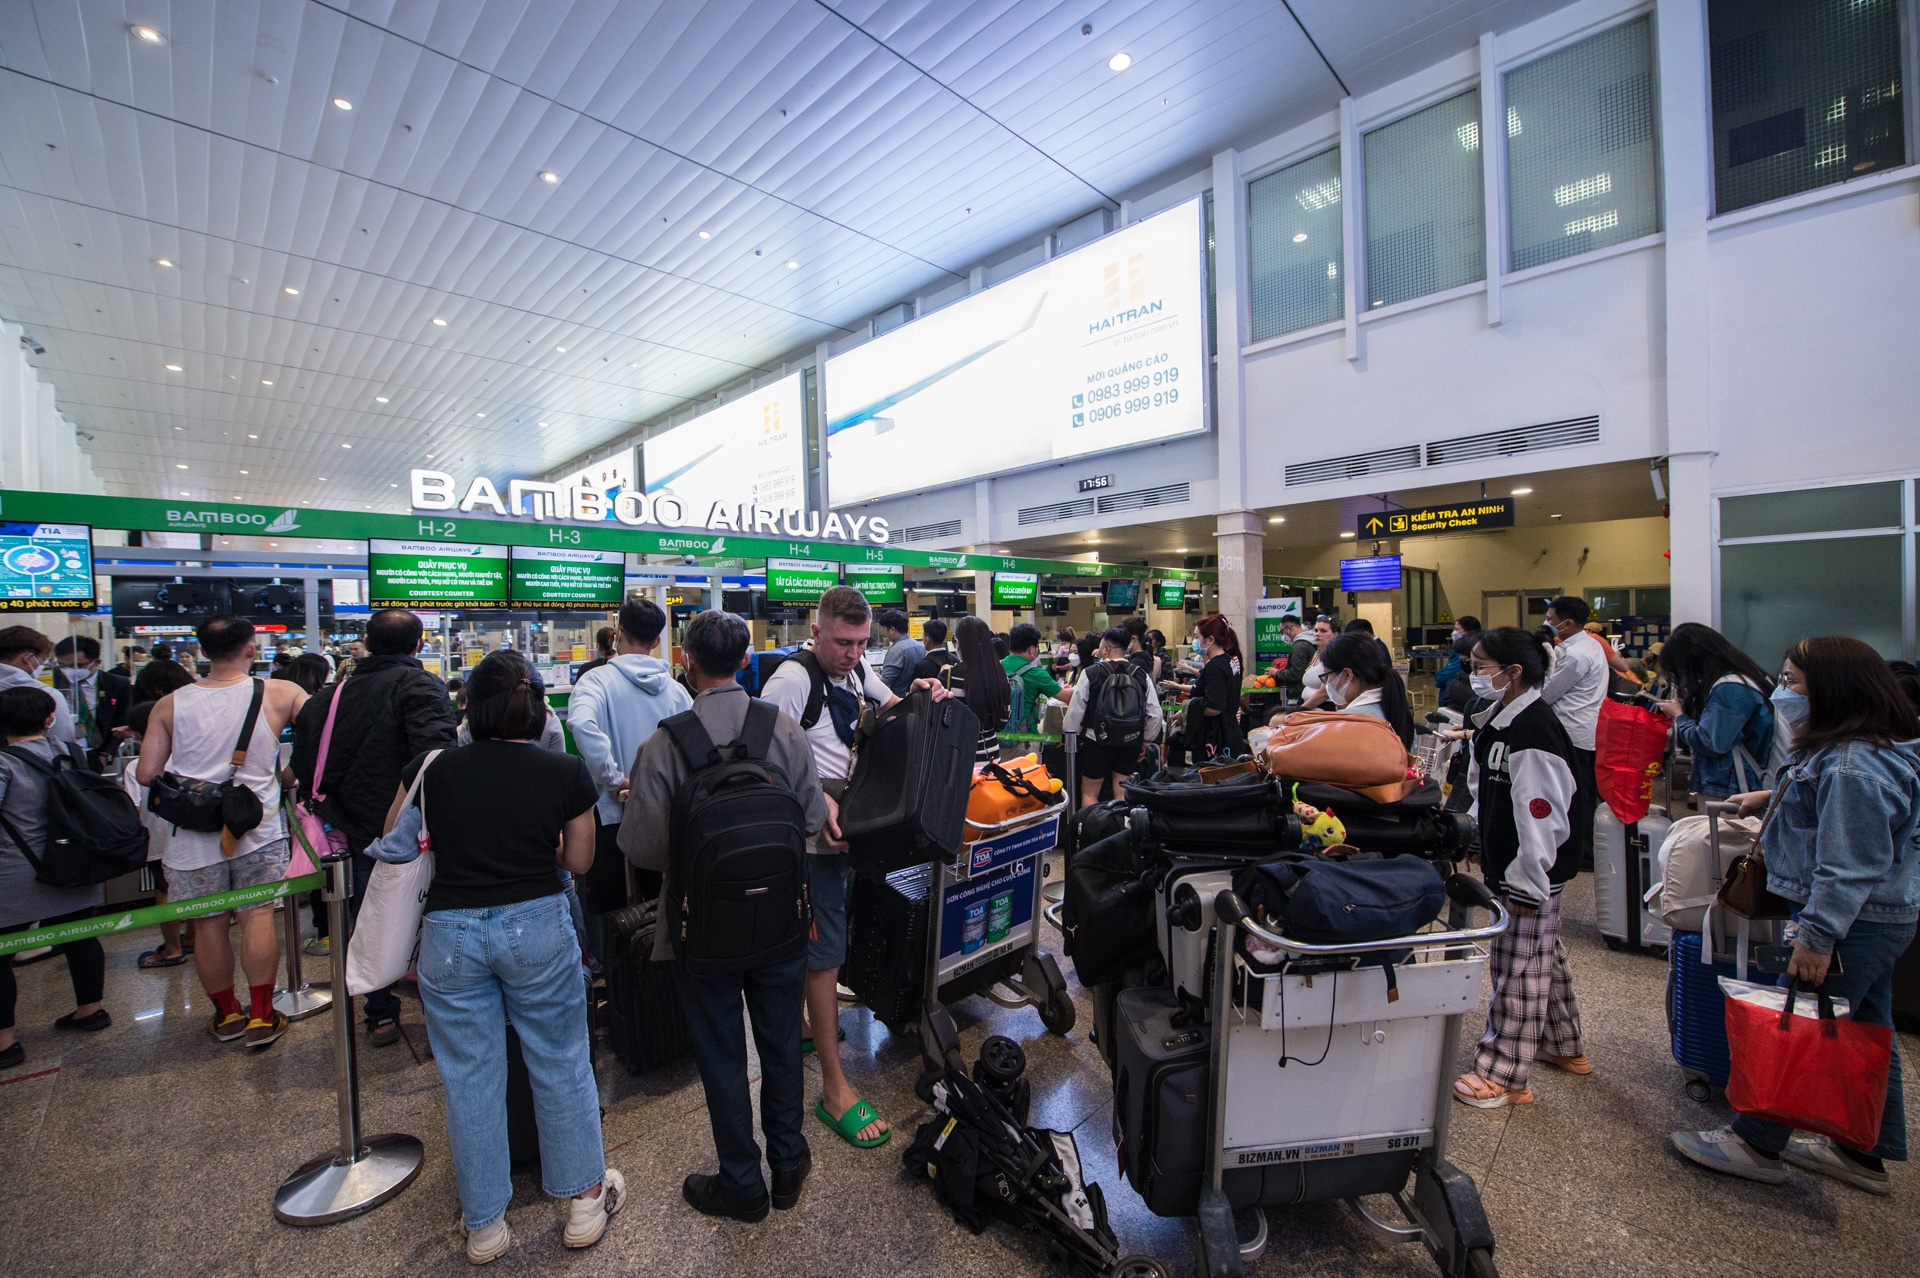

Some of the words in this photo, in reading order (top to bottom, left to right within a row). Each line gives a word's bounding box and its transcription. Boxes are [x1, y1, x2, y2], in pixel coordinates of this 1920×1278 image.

[1087, 371, 1106, 384] MỜI
[1107, 360, 1143, 378] QUẢNG
[1145, 353, 1168, 367] CÁO
[1088, 384, 1120, 403] 0983
[1124, 375, 1150, 394] 999
[1153, 367, 1179, 386] 919
[1089, 403, 1121, 423] 0906
[1125, 396, 1150, 414] 999
[1154, 388, 1179, 407] 919
[1084, 477, 1107, 489] 17:56
[411, 469, 688, 528] BAMBOO
[706, 500, 889, 544] AIRWAYS
[1411, 509, 1435, 522] KIỂM
[1438, 509, 1459, 519] TRA
[1460, 507, 1476, 517] AN
[1478, 504, 1505, 515] NINH
[166, 510, 266, 525] BAMBOO
[1411, 520, 1447, 531] Security
[1448, 517, 1478, 527] Check
[40, 527, 61, 535] TIA
[418, 520, 457, 538] H-2
[549, 529, 581, 544] H-3
[659, 539, 709, 549] BAMBOO
[789, 543, 810, 556] H-4
[866, 549, 883, 561] H-5
[929, 556, 957, 564] BAMBOO
[457, 562, 467, 572] VỤ
[1002, 559, 1015, 568] H-6
[26, 600, 50, 609] phút
[975, 852, 991, 863] TOA
[993, 847, 1006, 856] CÔNG
[946, 894, 960, 905] SƠN
[959, 887, 975, 899] CÔNG
[975, 881, 991, 893] NGHỆ
[991, 877, 1003, 887] CHO
[176, 898, 225, 914] BAMBOO
[228, 887, 275, 903] AIRWAYS
[995, 896, 1009, 908] TOA
[970, 906, 984, 918] TOA
[59, 921, 114, 938] AIRWAYS
[1304, 1144, 1340, 1154] BIZMAN
[1387, 1138, 1401, 1149] SG
[1403, 1136, 1420, 1147] 371
[1238, 1148, 1300, 1164] BIZMAN.VN
